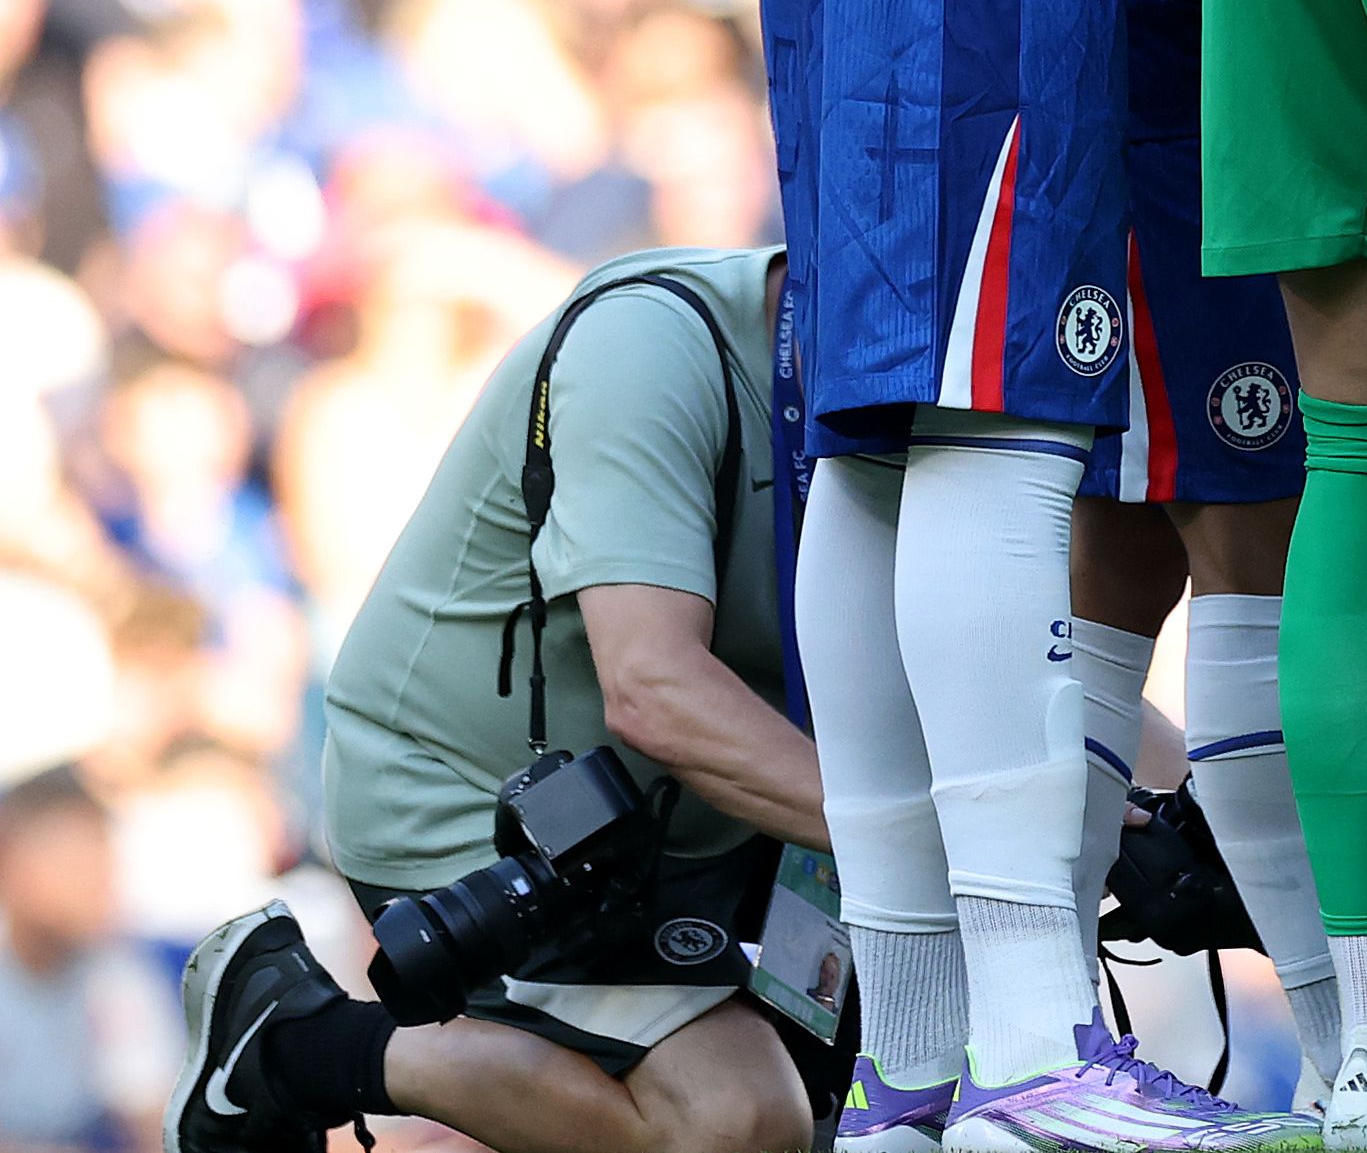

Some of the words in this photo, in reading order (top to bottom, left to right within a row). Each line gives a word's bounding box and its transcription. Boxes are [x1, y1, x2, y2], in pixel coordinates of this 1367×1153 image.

[1069, 289, 1111, 309] CHELSEA
[778, 310, 795, 379] CHELSEA
[1220, 365, 1275, 388] CHELSEA
[532, 380, 548, 450] Nikon
